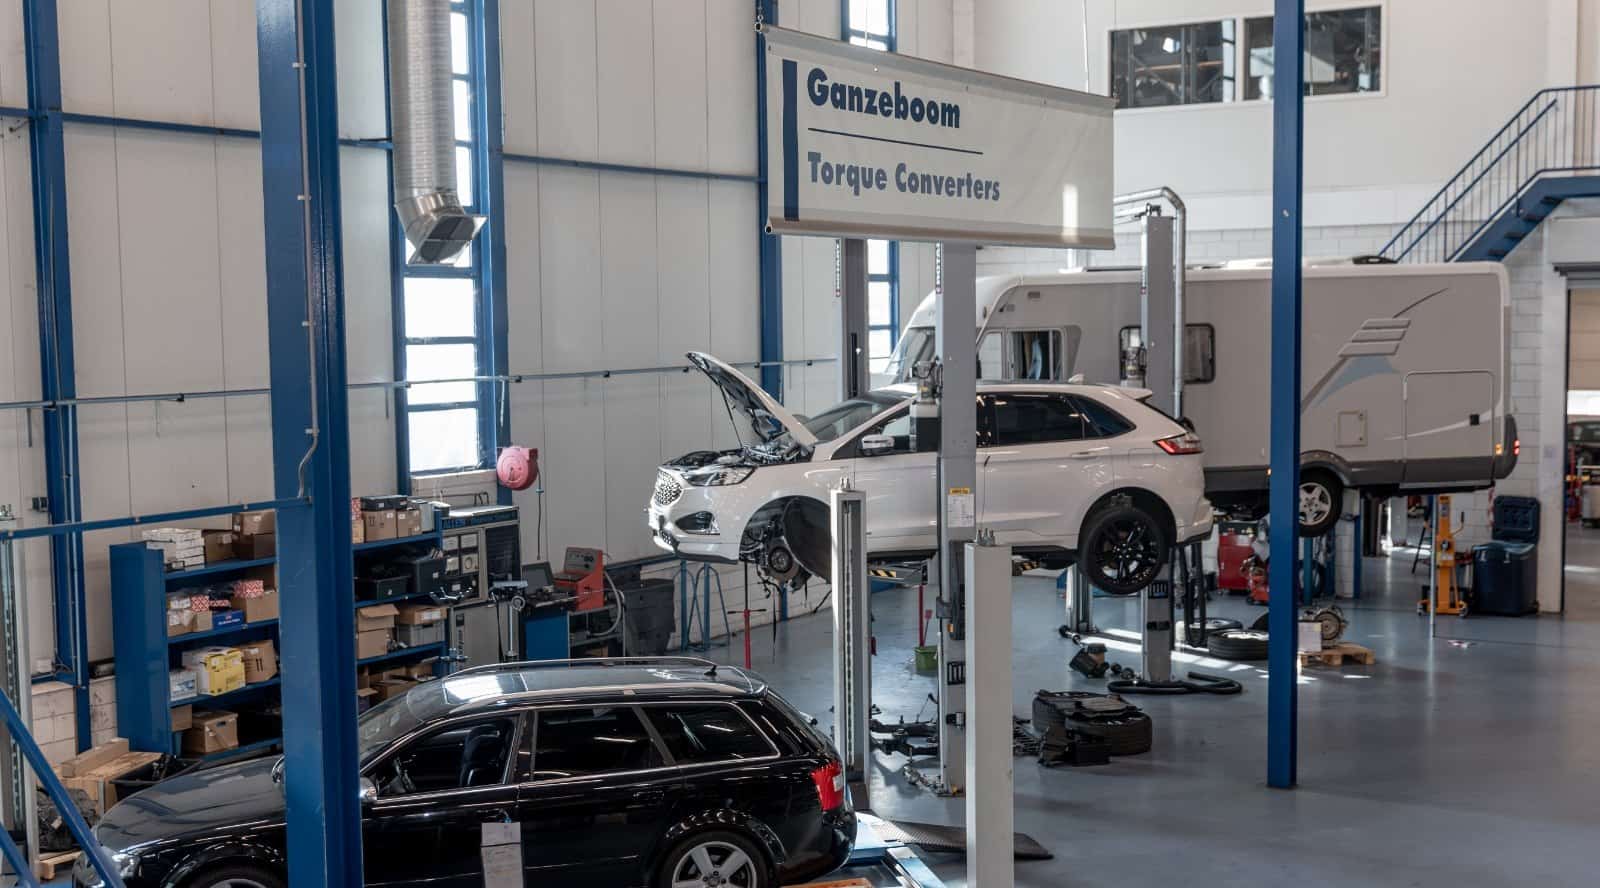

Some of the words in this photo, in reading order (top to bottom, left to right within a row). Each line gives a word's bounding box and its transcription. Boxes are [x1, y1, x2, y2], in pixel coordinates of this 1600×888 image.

[807, 67, 961, 129] Ganzeboom
[807, 152, 887, 197] Torque
[895, 162, 1001, 202] Converters
